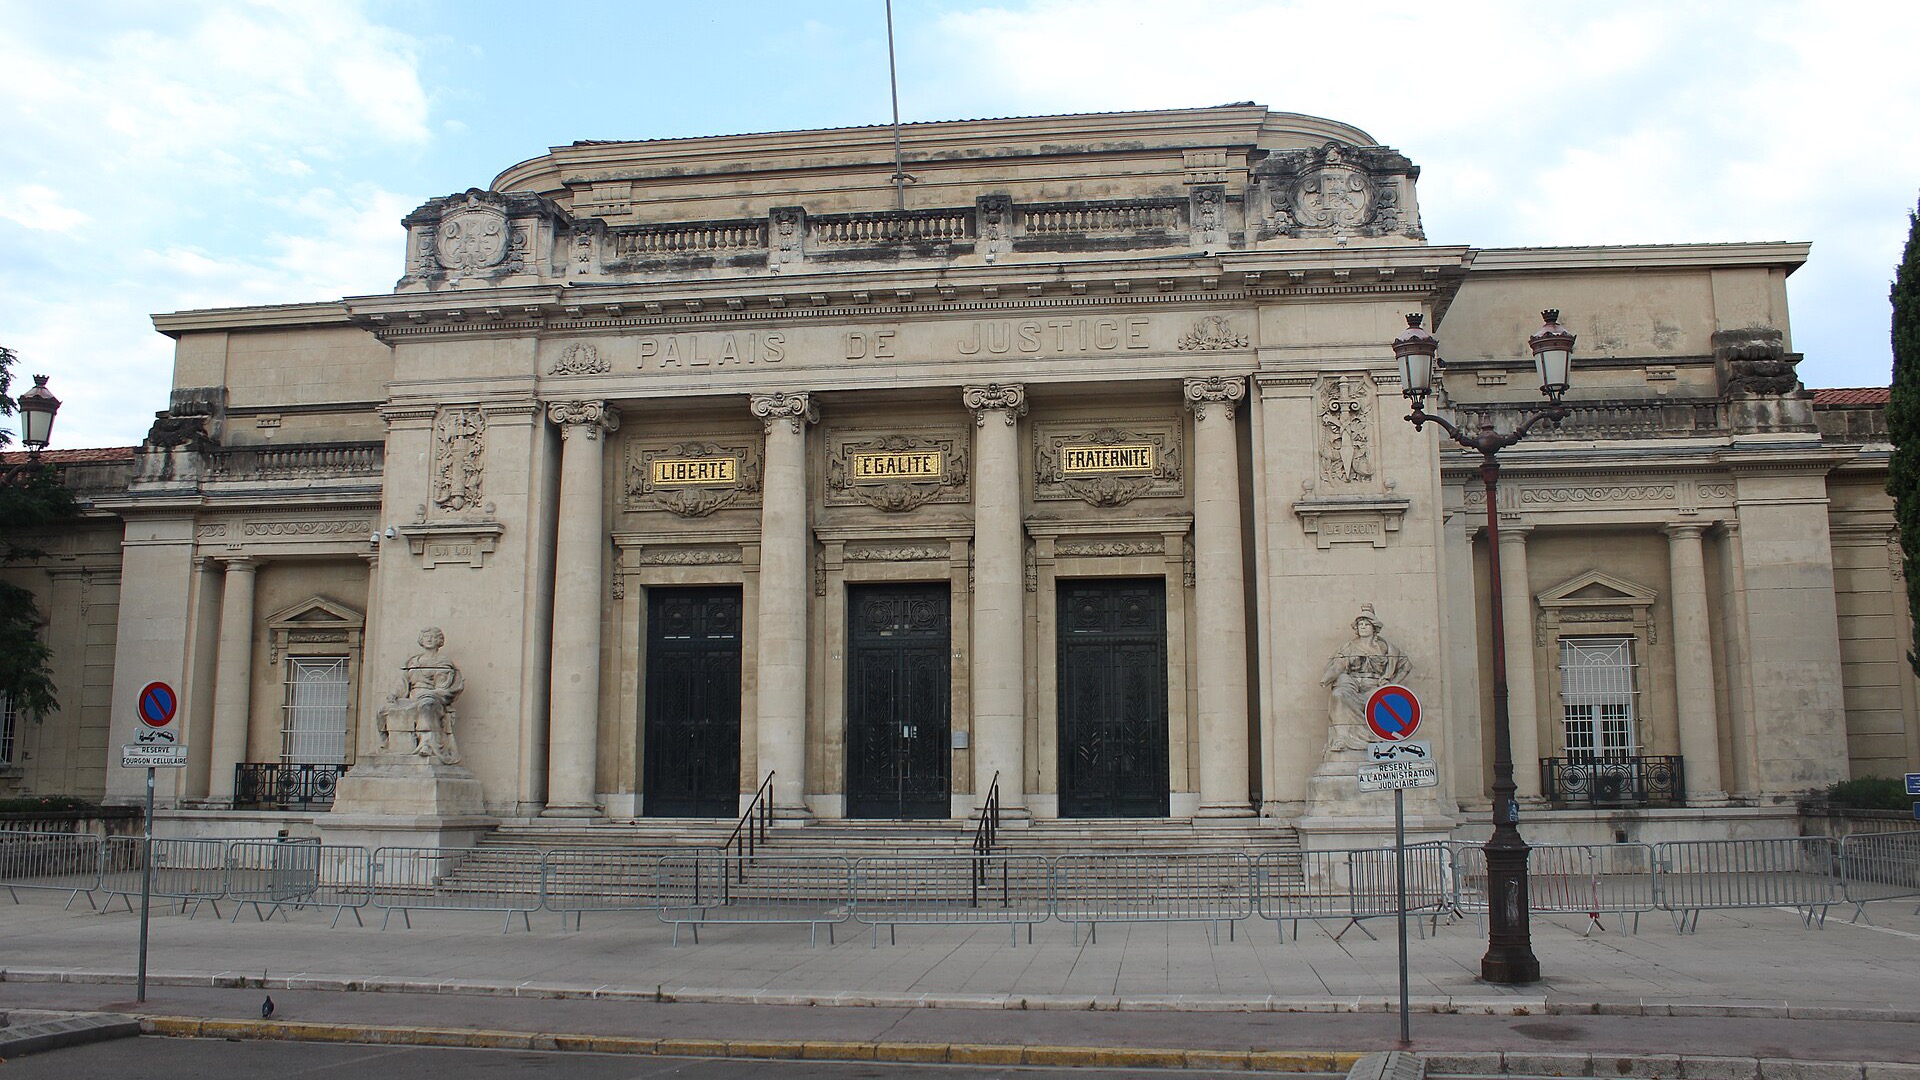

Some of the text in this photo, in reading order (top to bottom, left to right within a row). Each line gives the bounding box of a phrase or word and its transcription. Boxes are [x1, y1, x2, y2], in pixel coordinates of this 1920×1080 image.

[637, 315, 1151, 369] PALAIS DE JUSTICE
[661, 461, 727, 480] LIBERTÉ
[1326, 523, 1377, 535] LE DROIT
[434, 545, 472, 556] LA LOI
[122, 757, 187, 765] FOURGON CELLULAIRE
[1367, 768, 1435, 782] L'ADMINISTRATION
[1378, 779, 1419, 790] JUDICIAIRE
